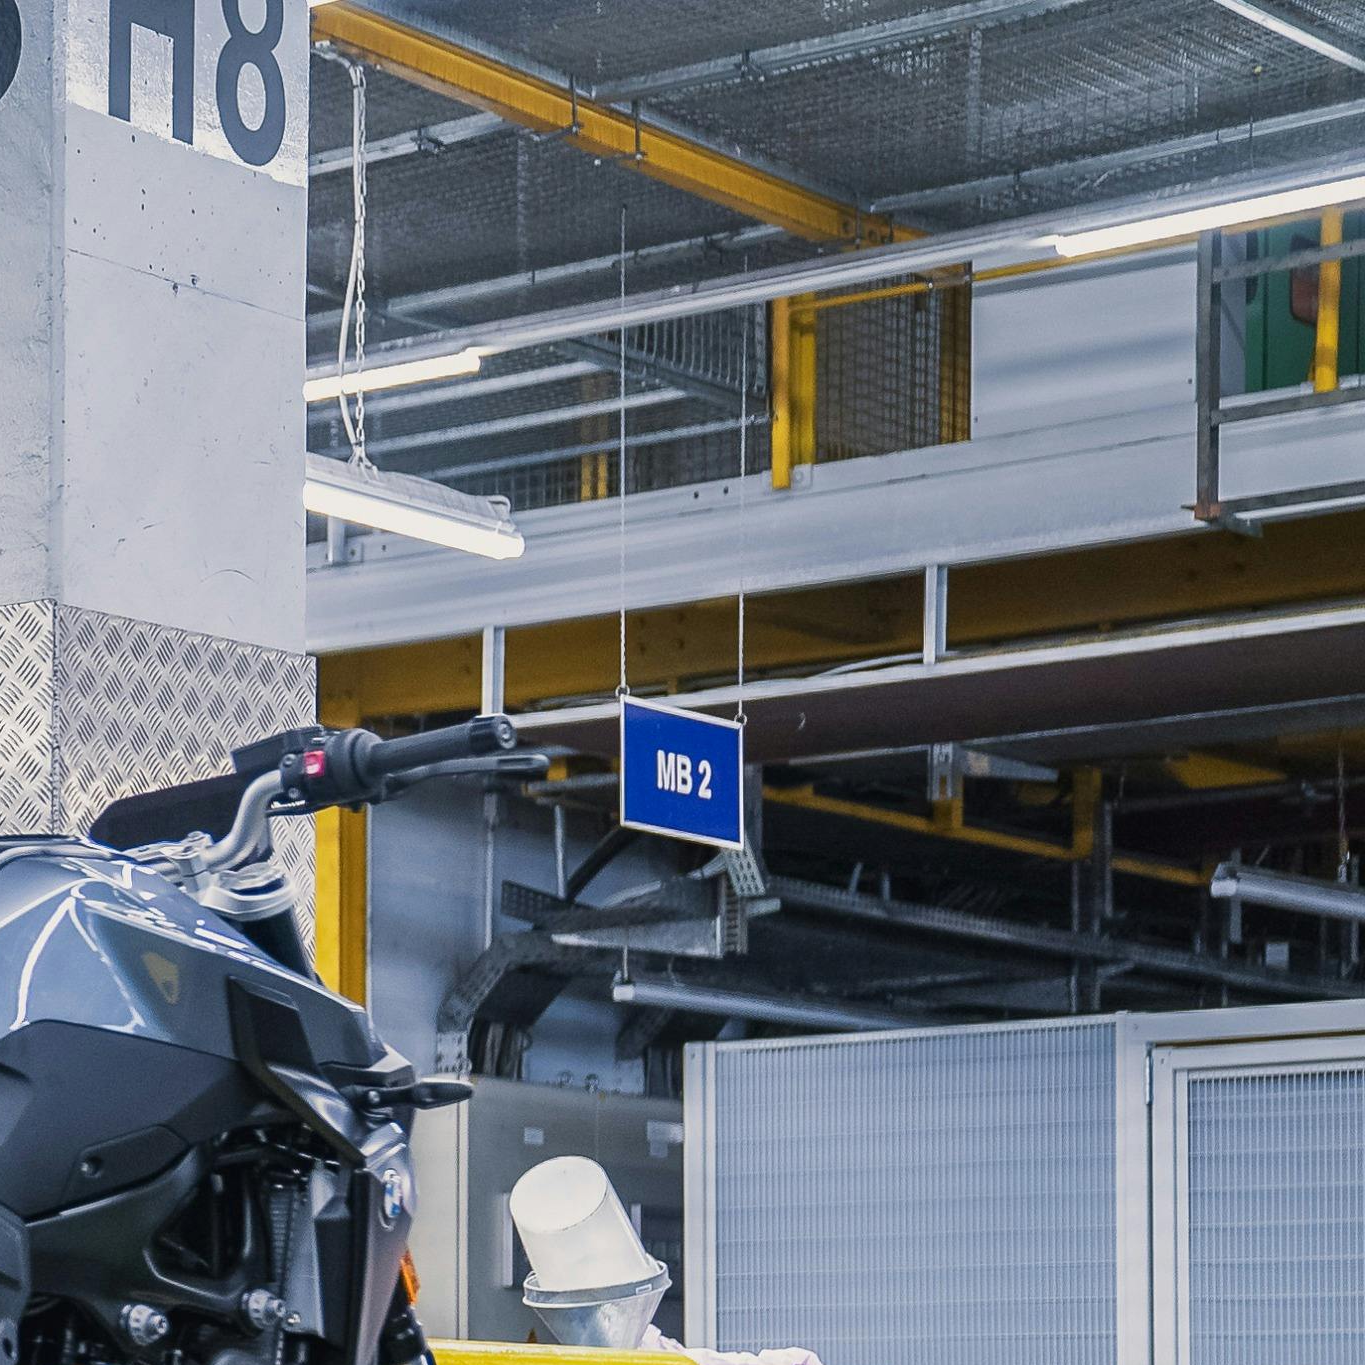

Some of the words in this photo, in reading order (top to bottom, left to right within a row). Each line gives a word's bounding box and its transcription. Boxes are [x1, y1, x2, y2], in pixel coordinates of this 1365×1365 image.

[108, 0, 287, 167] H8
[657, 749, 693, 795] MB
[698, 759, 712, 800] 2
